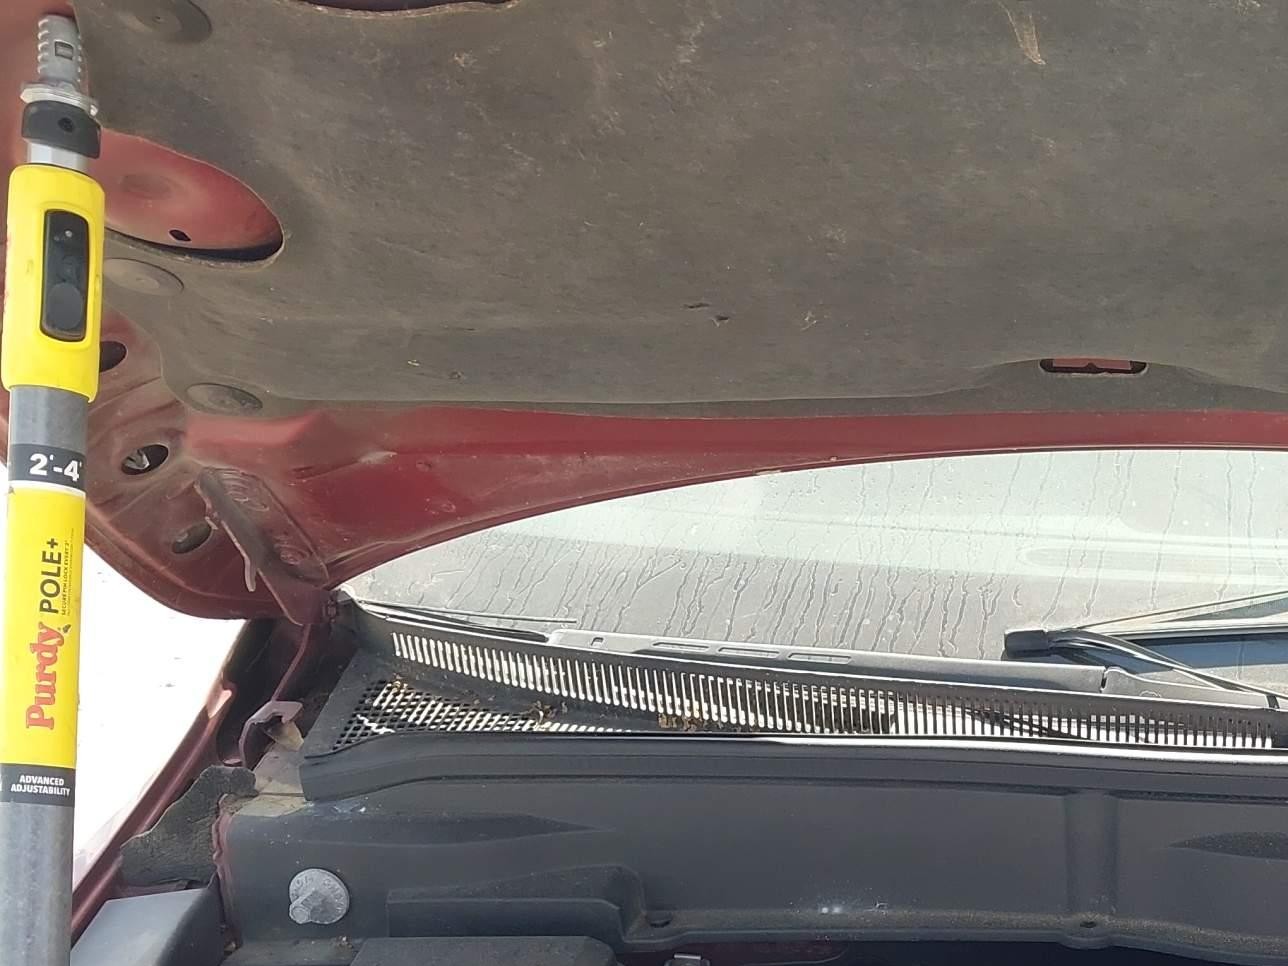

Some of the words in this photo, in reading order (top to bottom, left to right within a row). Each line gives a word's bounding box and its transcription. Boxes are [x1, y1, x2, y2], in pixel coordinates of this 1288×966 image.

[40, 538, 62, 614] POLE+
[26, 621, 65, 730] Purdy
[10, 783, 71, 797] ADJUSTABILITY
[19, 774, 65, 786] ADVANCED
